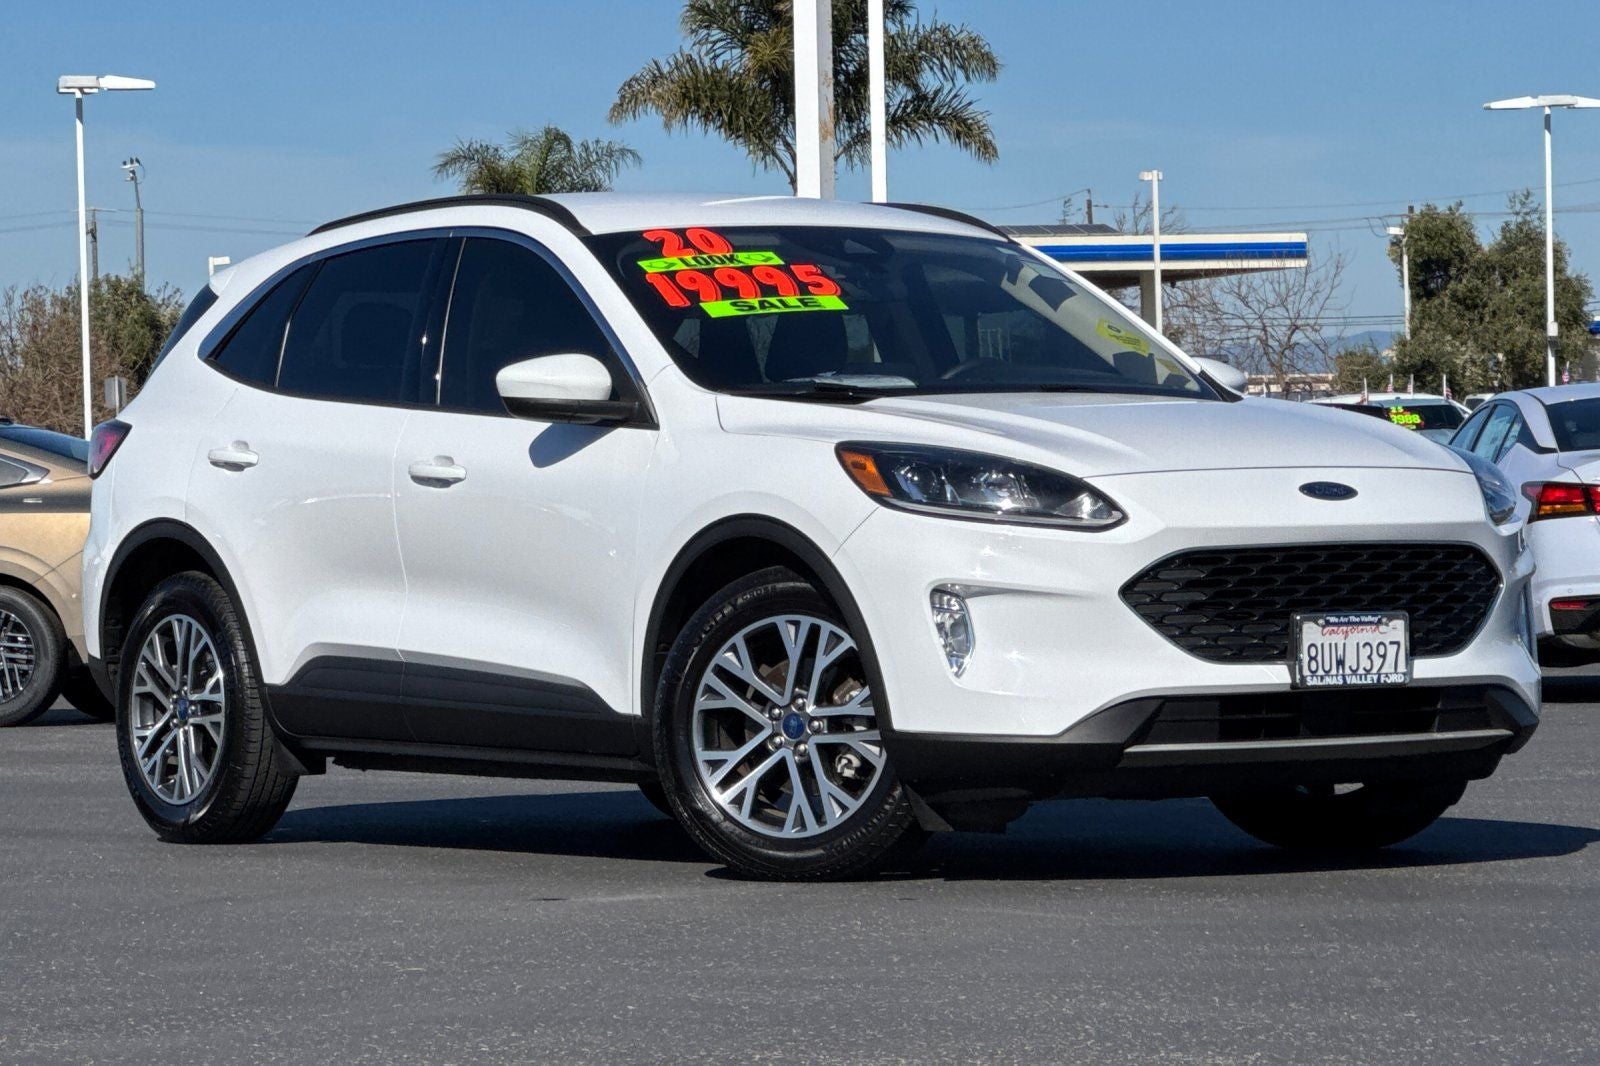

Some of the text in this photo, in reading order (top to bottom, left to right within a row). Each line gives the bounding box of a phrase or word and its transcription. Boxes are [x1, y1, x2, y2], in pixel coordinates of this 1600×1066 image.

[643, 228, 733, 258] 20
[677, 253, 745, 268] LOOK
[646, 264, 841, 307] 19995
[729, 297, 822, 313] SALE
[1321, 626, 1387, 640] California
[1307, 641, 1401, 674] 8UWJ397
[1306, 673, 1404, 686] SALINAS VALLEY FORD
